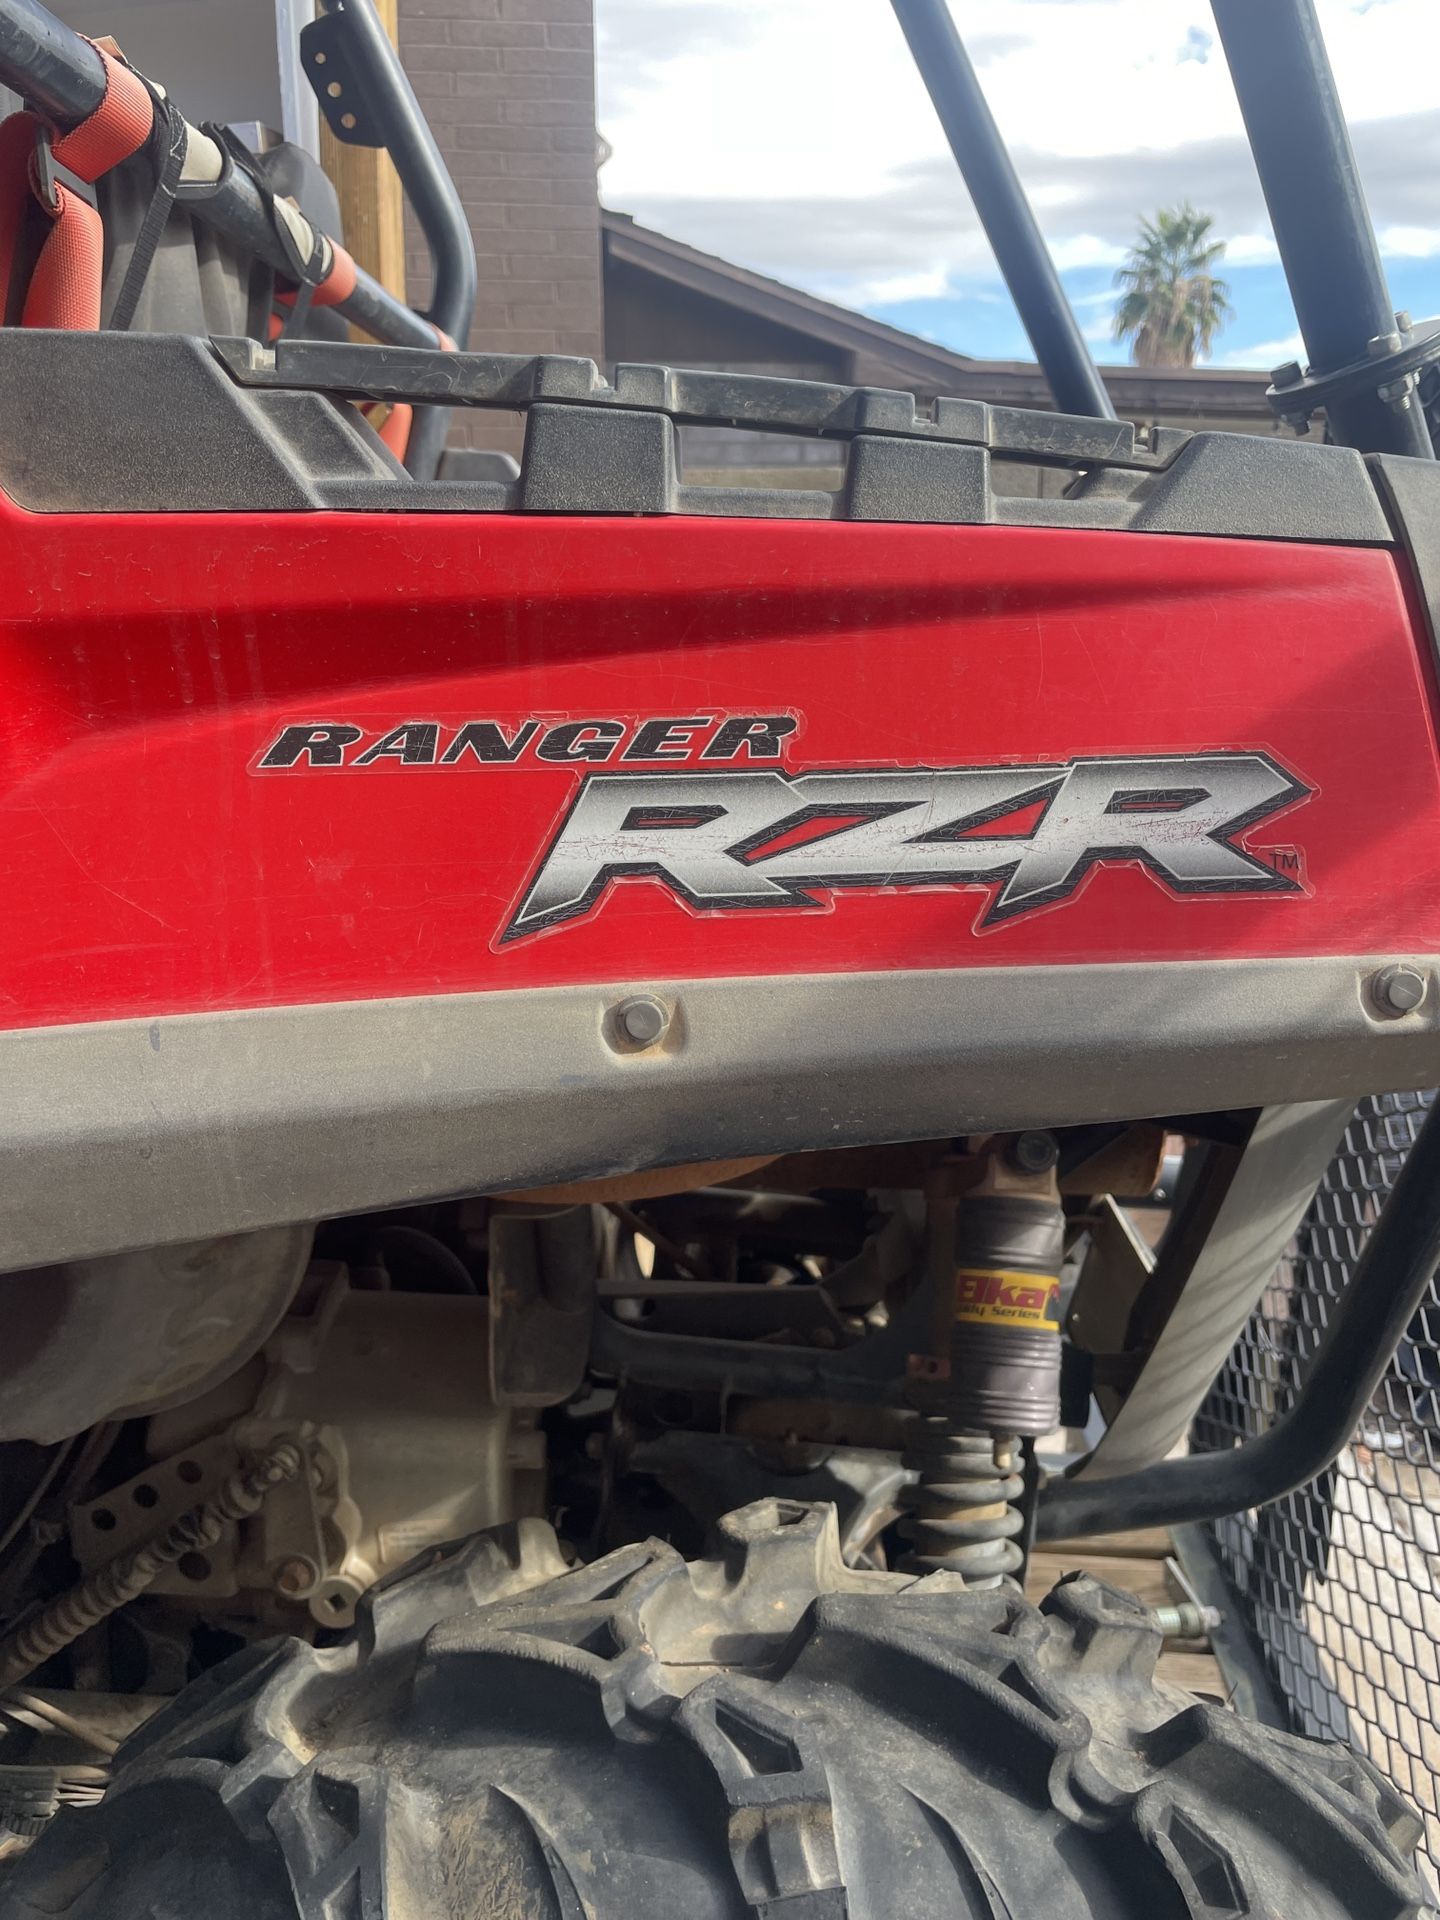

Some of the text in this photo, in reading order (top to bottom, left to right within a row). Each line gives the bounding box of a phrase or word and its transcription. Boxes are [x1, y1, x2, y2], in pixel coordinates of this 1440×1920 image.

[257, 715, 799, 768] RANGER
[499, 750, 1313, 945] RZR TM
